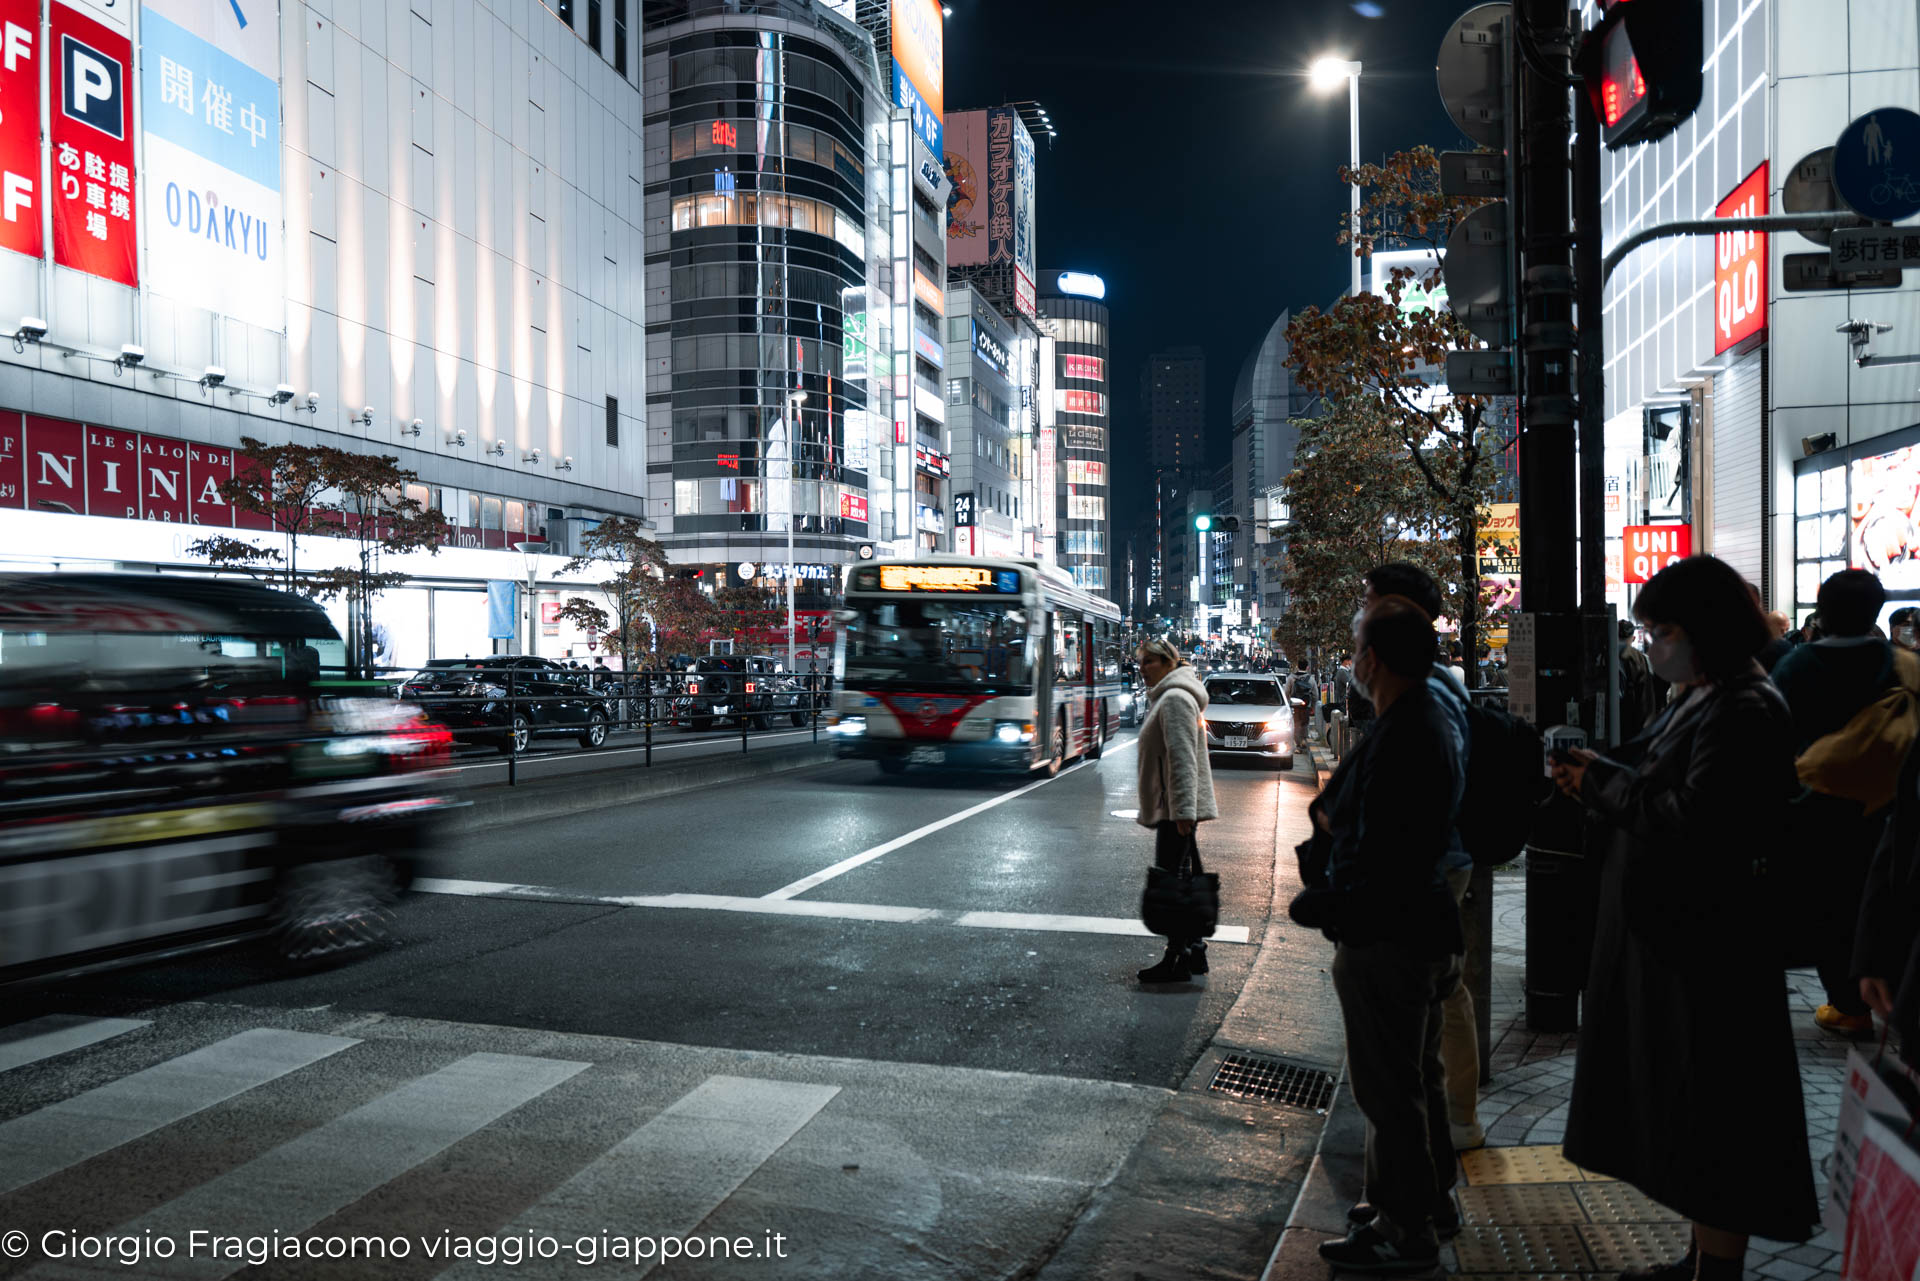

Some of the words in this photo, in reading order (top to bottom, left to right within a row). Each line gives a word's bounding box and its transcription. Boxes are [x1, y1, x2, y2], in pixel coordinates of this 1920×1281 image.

[73, 50, 112, 113] P
[160, 54, 267, 148] 開催中
[926, 115, 938, 147] 6F
[58, 142, 81, 200] あり
[84, 151, 108, 241] 駐車場
[109, 161, 130, 221] 提携
[989, 113, 1013, 263] カラオケの鉄人
[166, 181, 267, 261] ODAKYU
[1719, 194, 1756, 269] UNI
[1720, 260, 1759, 340] QLO
[91, 433, 116, 449] LE
[126, 439, 200, 462] SALON
[207, 453, 230, 467] DE
[126, 506, 200, 525] PARIS
[955, 497, 971, 512] 24
[957, 512, 968, 523] H
[1482, 558, 1520, 567] WESTE
[1633, 531, 1678, 553] UNI
